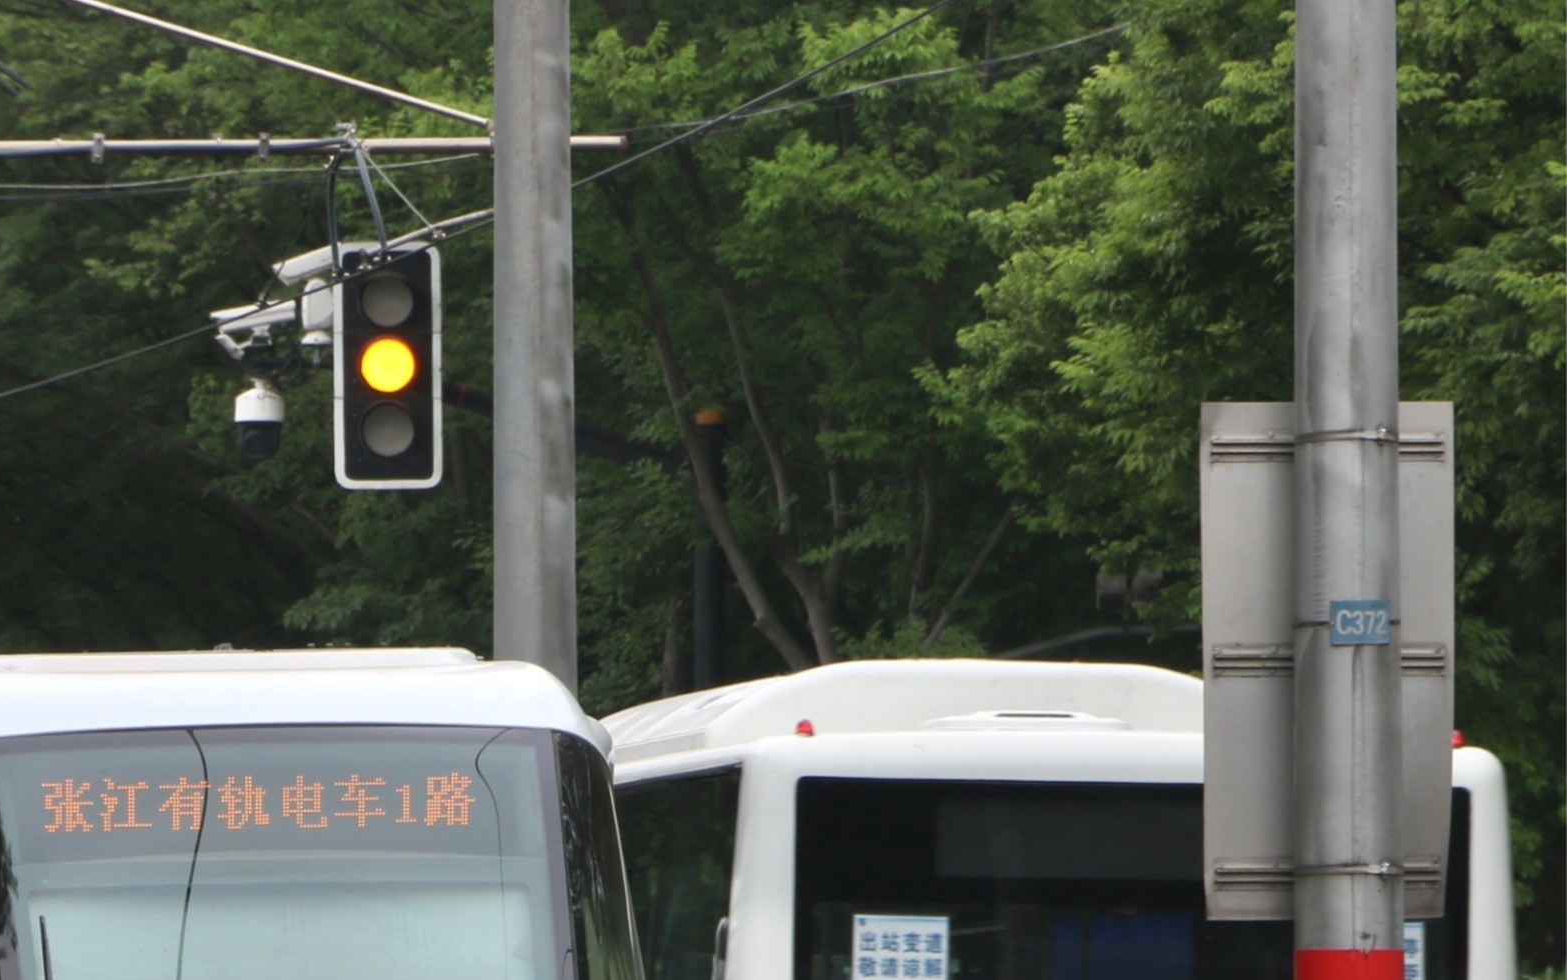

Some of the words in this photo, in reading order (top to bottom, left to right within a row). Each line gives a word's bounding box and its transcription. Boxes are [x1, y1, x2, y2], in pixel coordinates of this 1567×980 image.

[1336, 608, 1388, 635] C372
[41, 772, 476, 832] 张江有轨电车1路
[859, 931, 944, 954] 出站变道
